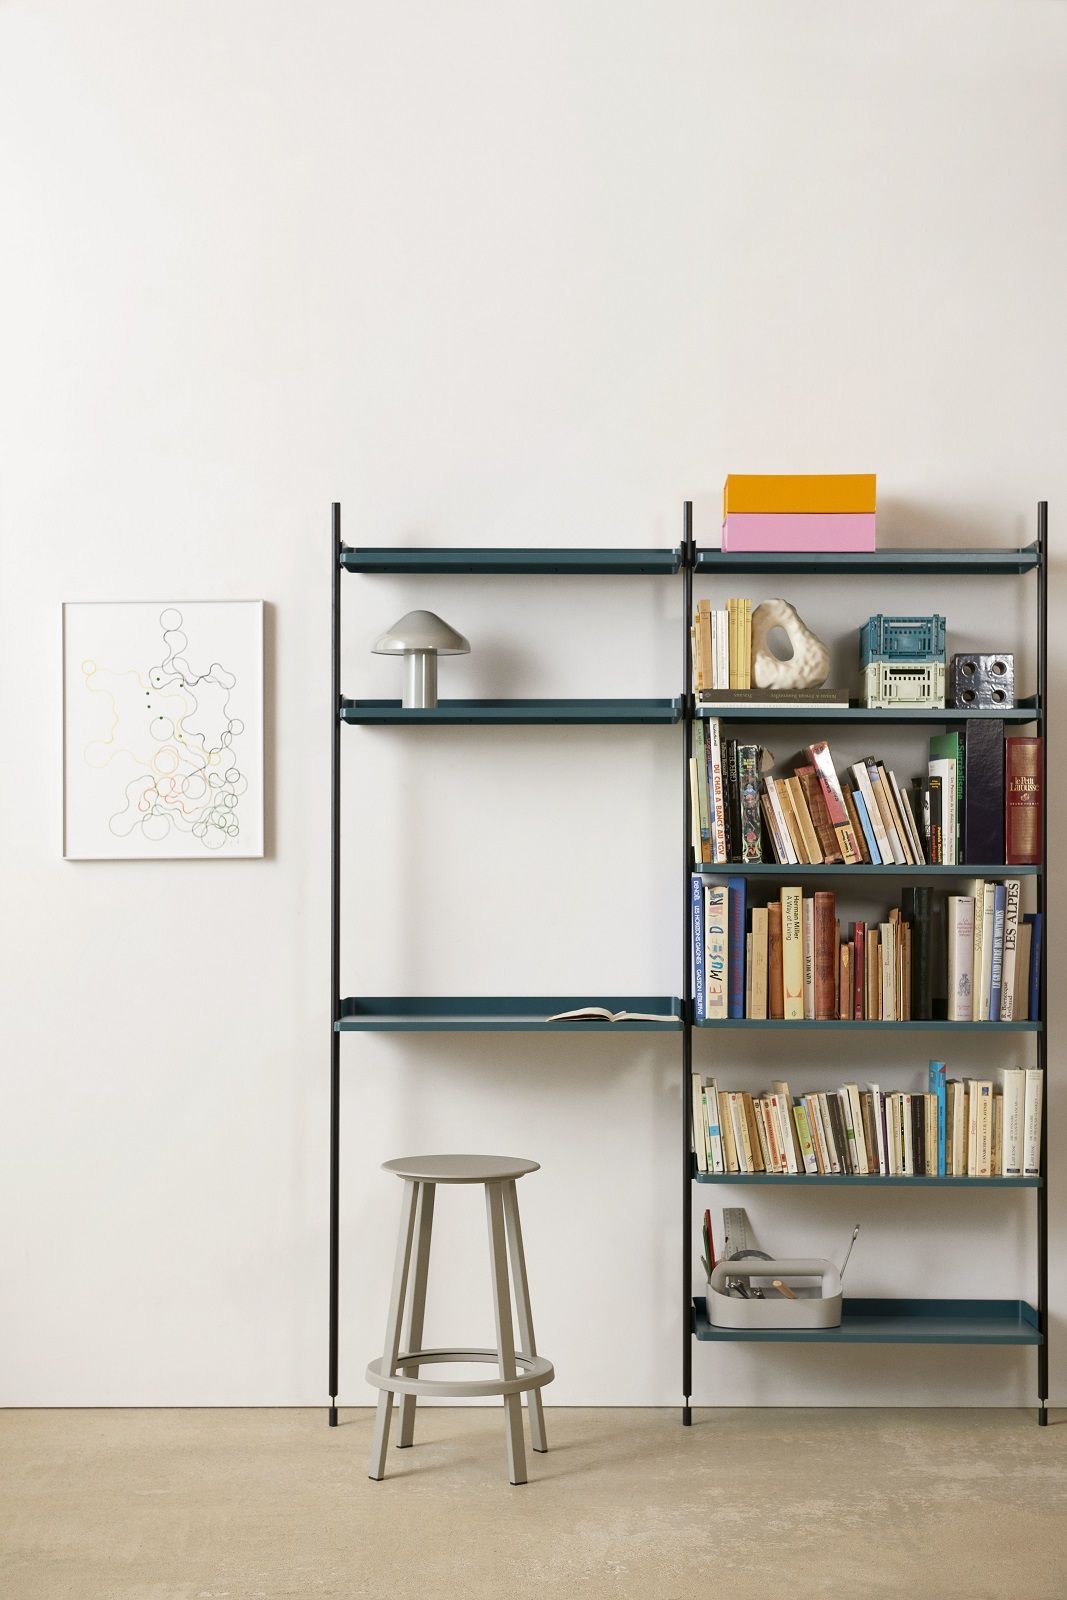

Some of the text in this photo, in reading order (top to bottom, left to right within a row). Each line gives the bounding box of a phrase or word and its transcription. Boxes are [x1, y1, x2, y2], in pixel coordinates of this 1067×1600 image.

[1009, 782, 1040, 792] Larousse
[1014, 776, 1034, 785] le Petit
[714, 764, 720, 773] DU
[717, 829, 723, 838] AU
[1005, 883, 1019, 951] LES ALPES
[992, 963, 1001, 981] GRAND
[992, 981, 1000, 989] LE
[709, 984, 724, 1007] LE
